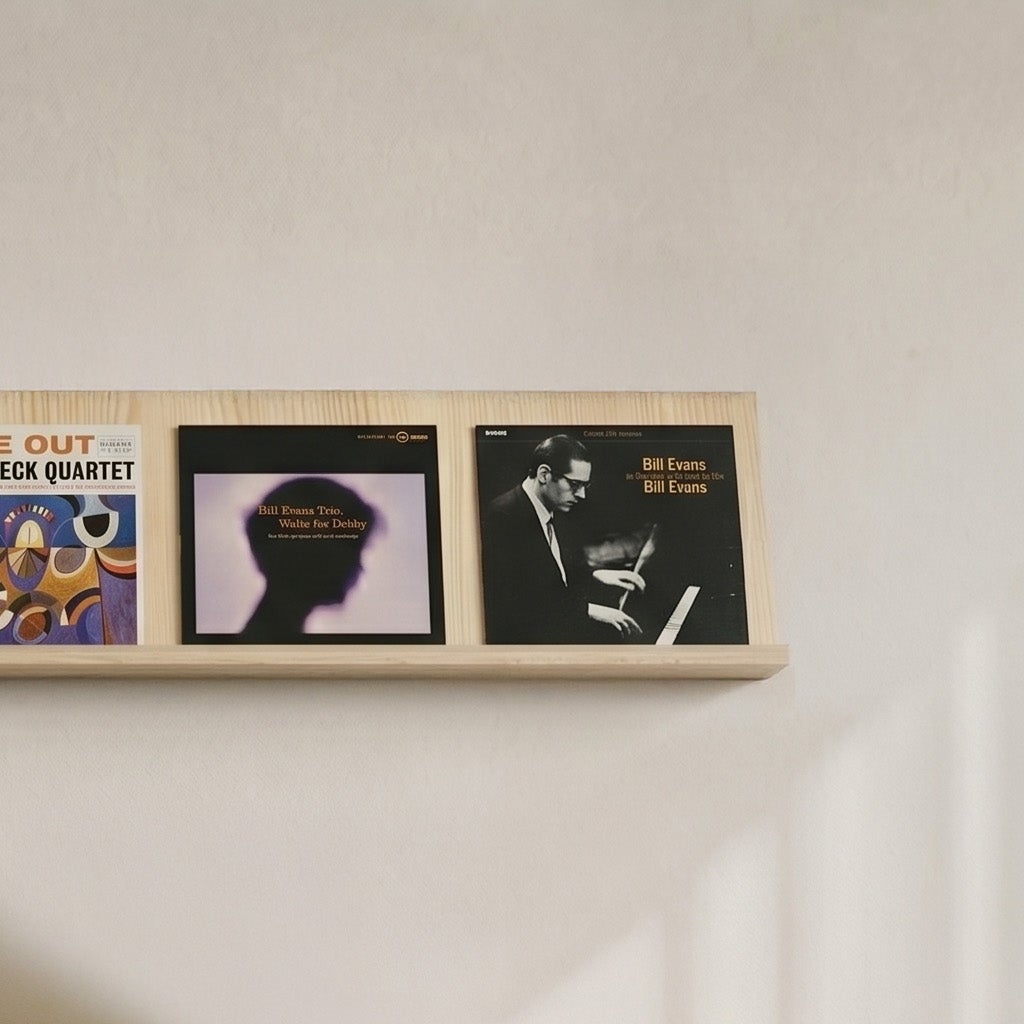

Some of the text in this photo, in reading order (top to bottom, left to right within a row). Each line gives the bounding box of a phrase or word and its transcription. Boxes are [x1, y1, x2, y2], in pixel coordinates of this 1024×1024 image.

[24, 435, 95, 455] OUT
[643, 457, 707, 471] Bill Evans
[45, 461, 135, 485] QUARTET
[644, 480, 708, 494] Bill Evans
[258, 505, 279, 515] Bill
